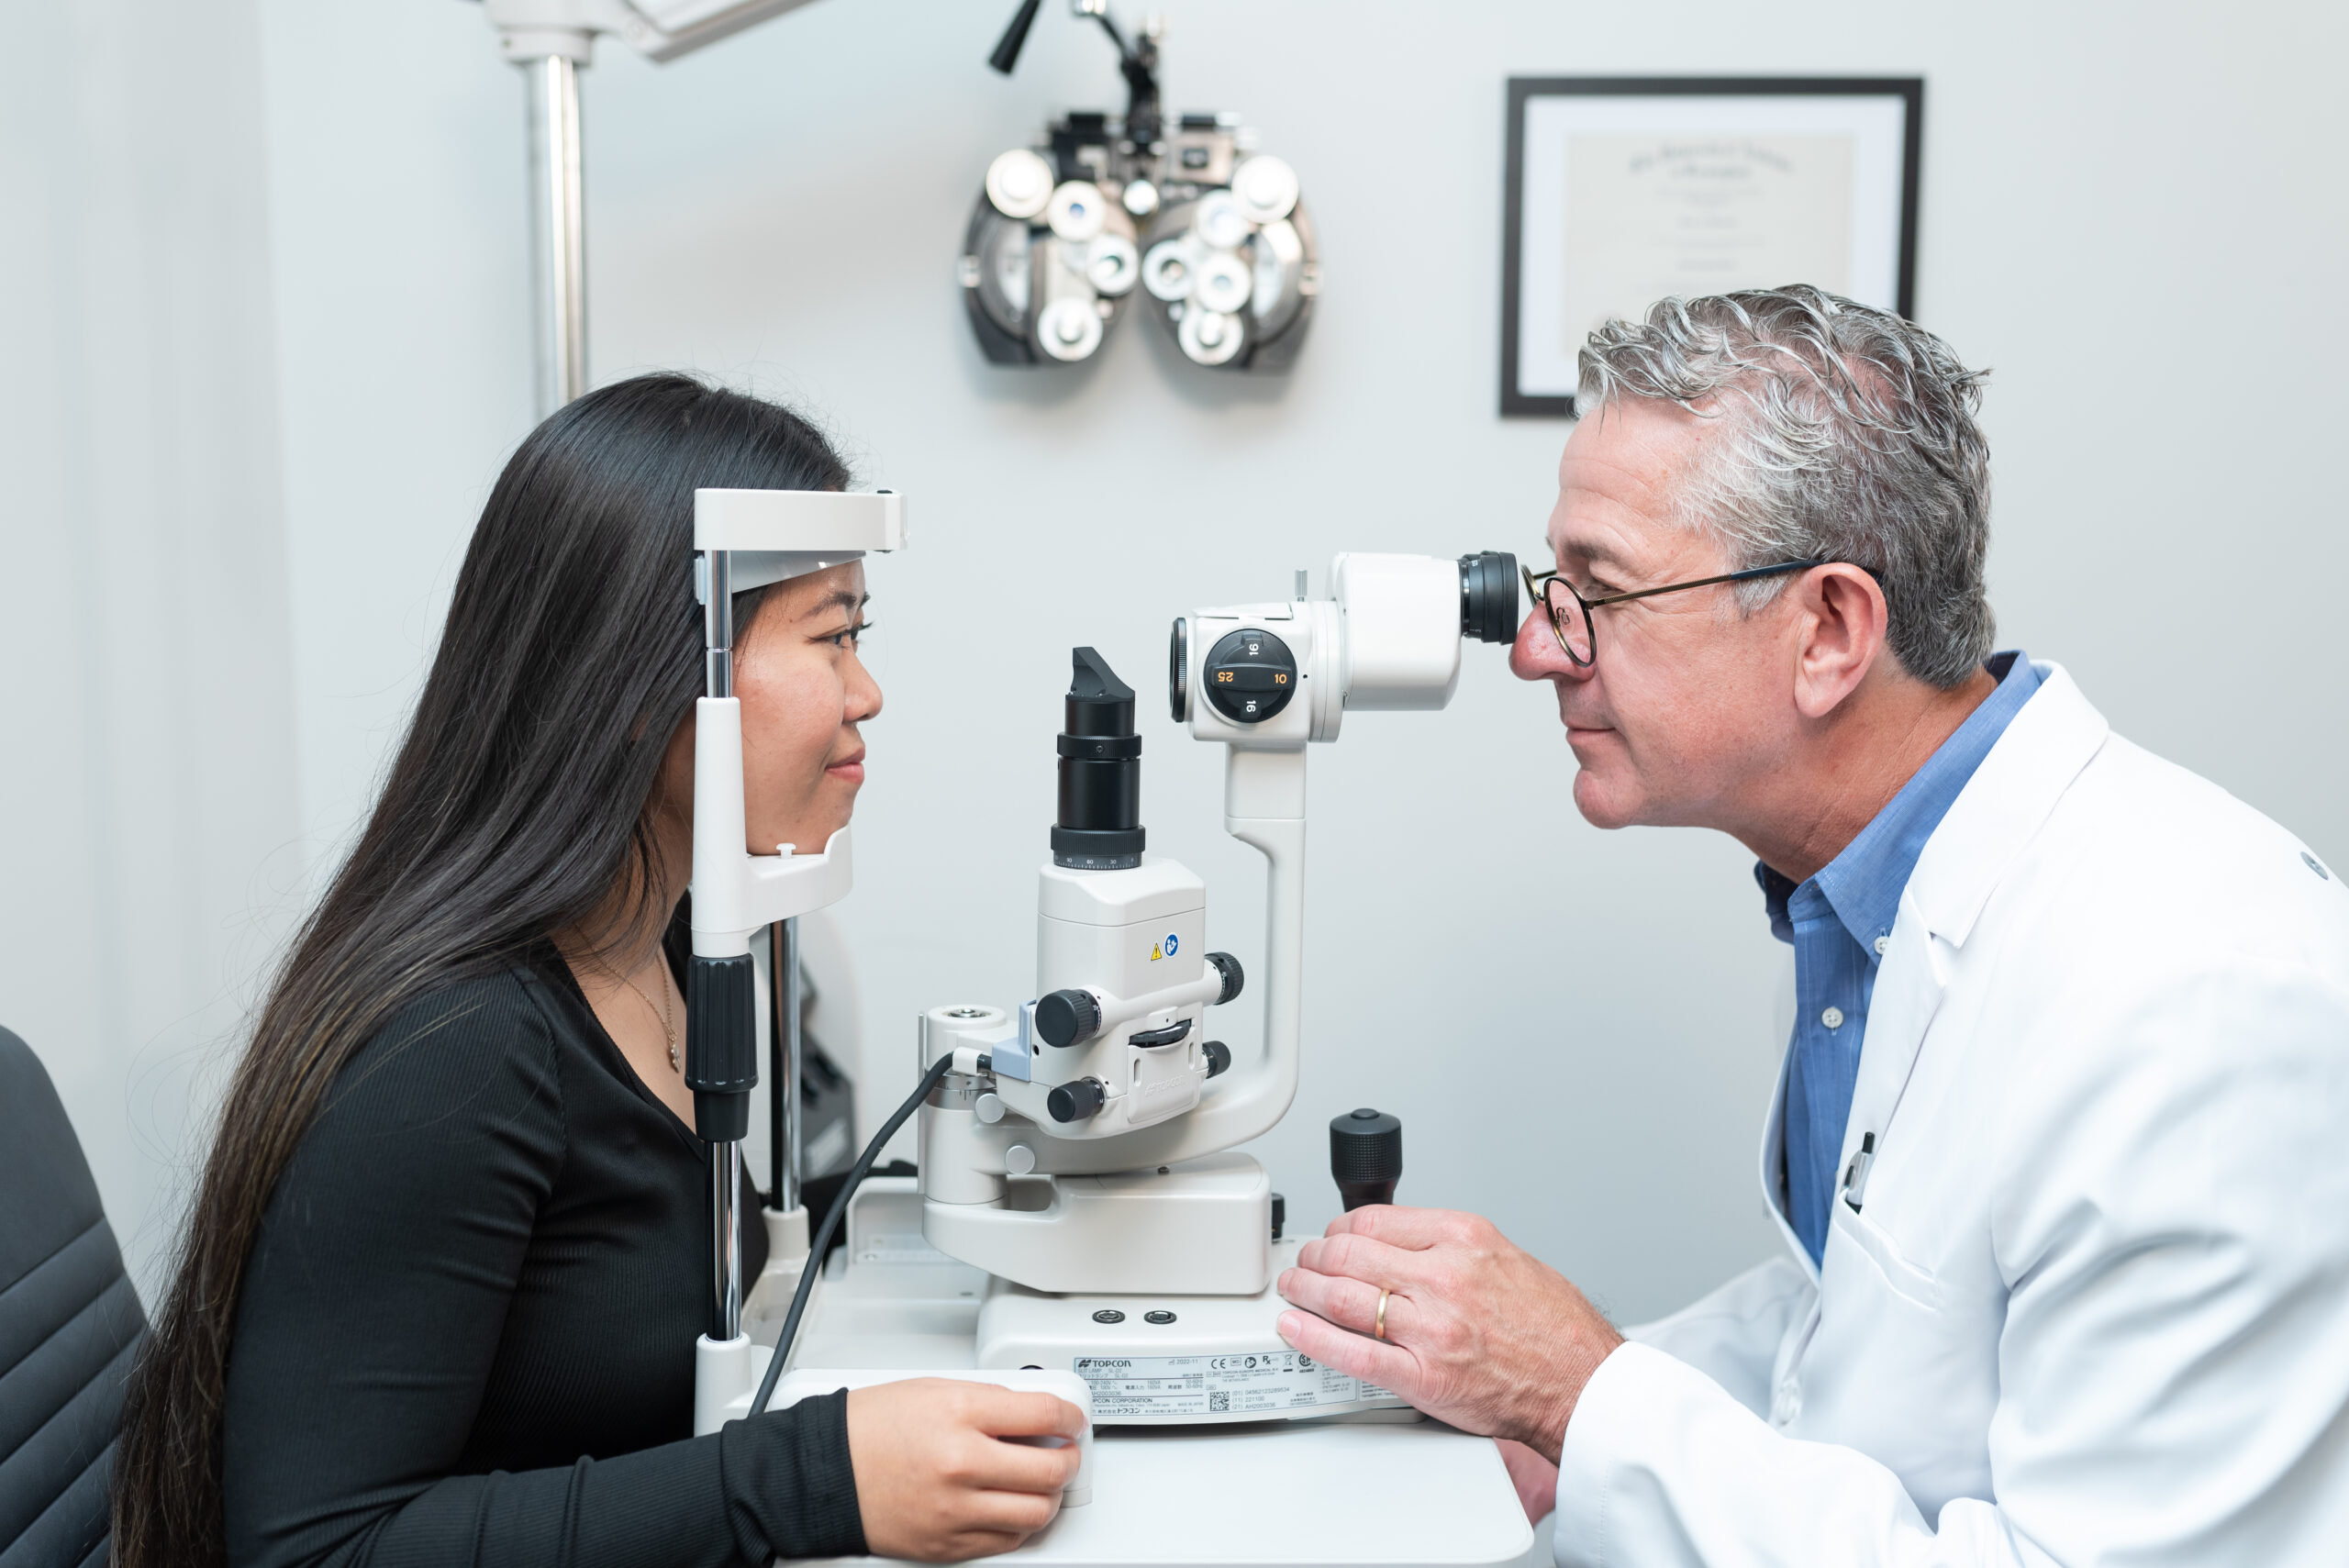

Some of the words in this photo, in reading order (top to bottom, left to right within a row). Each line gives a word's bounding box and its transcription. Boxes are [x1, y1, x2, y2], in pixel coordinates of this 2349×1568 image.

[1249, 643, 1259, 656] 16
[1218, 672, 1234, 682] 25
[1275, 674, 1287, 684] 10
[1246, 700, 1257, 712] 16
[1211, 1359, 1226, 1369] CE
